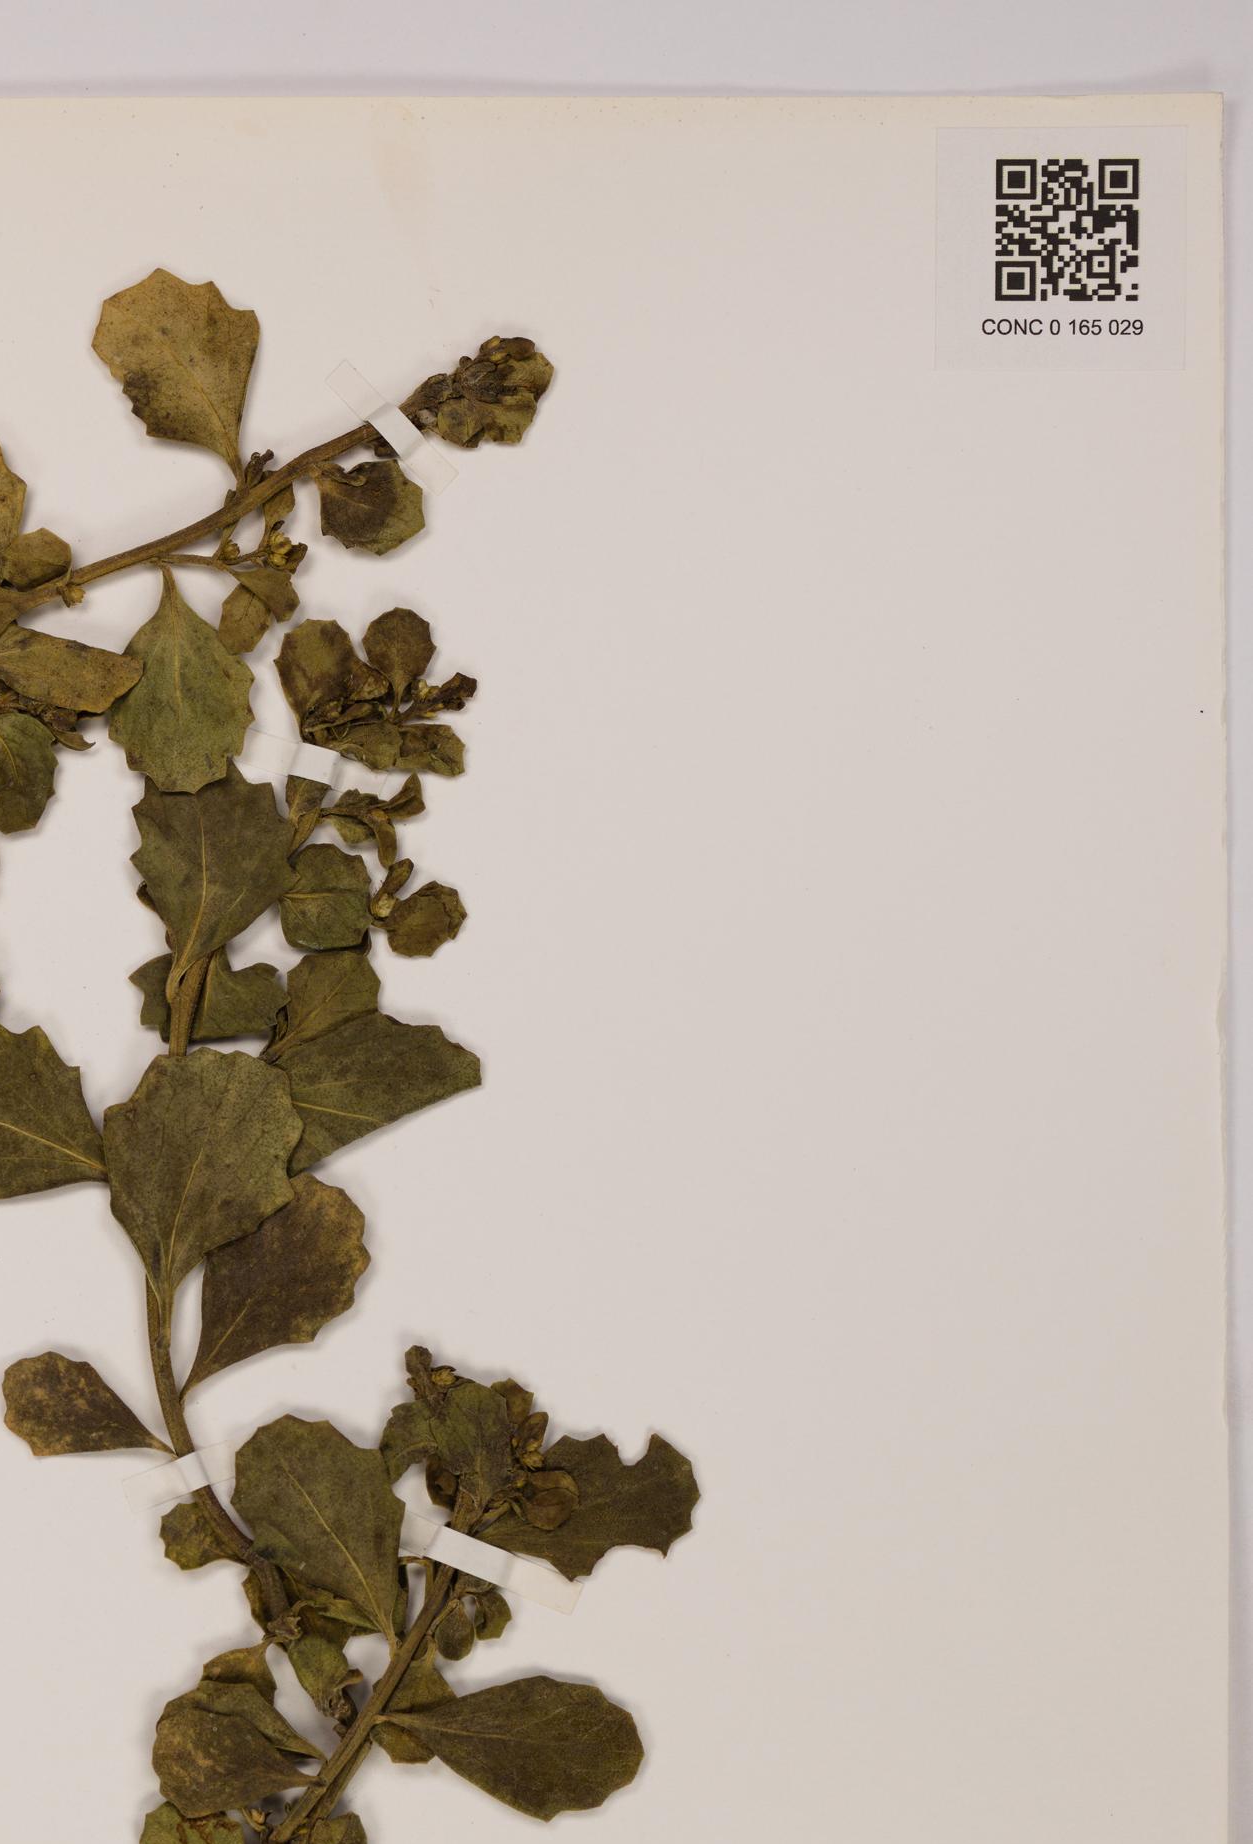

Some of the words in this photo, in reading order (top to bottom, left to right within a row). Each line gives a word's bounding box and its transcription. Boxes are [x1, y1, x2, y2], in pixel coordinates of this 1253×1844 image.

[981, 318, 1043, 336] CONC
[1049, 319, 1061, 336] 0
[1068, 318, 1103, 336] 165
[1108, 319, 1144, 336] 029
